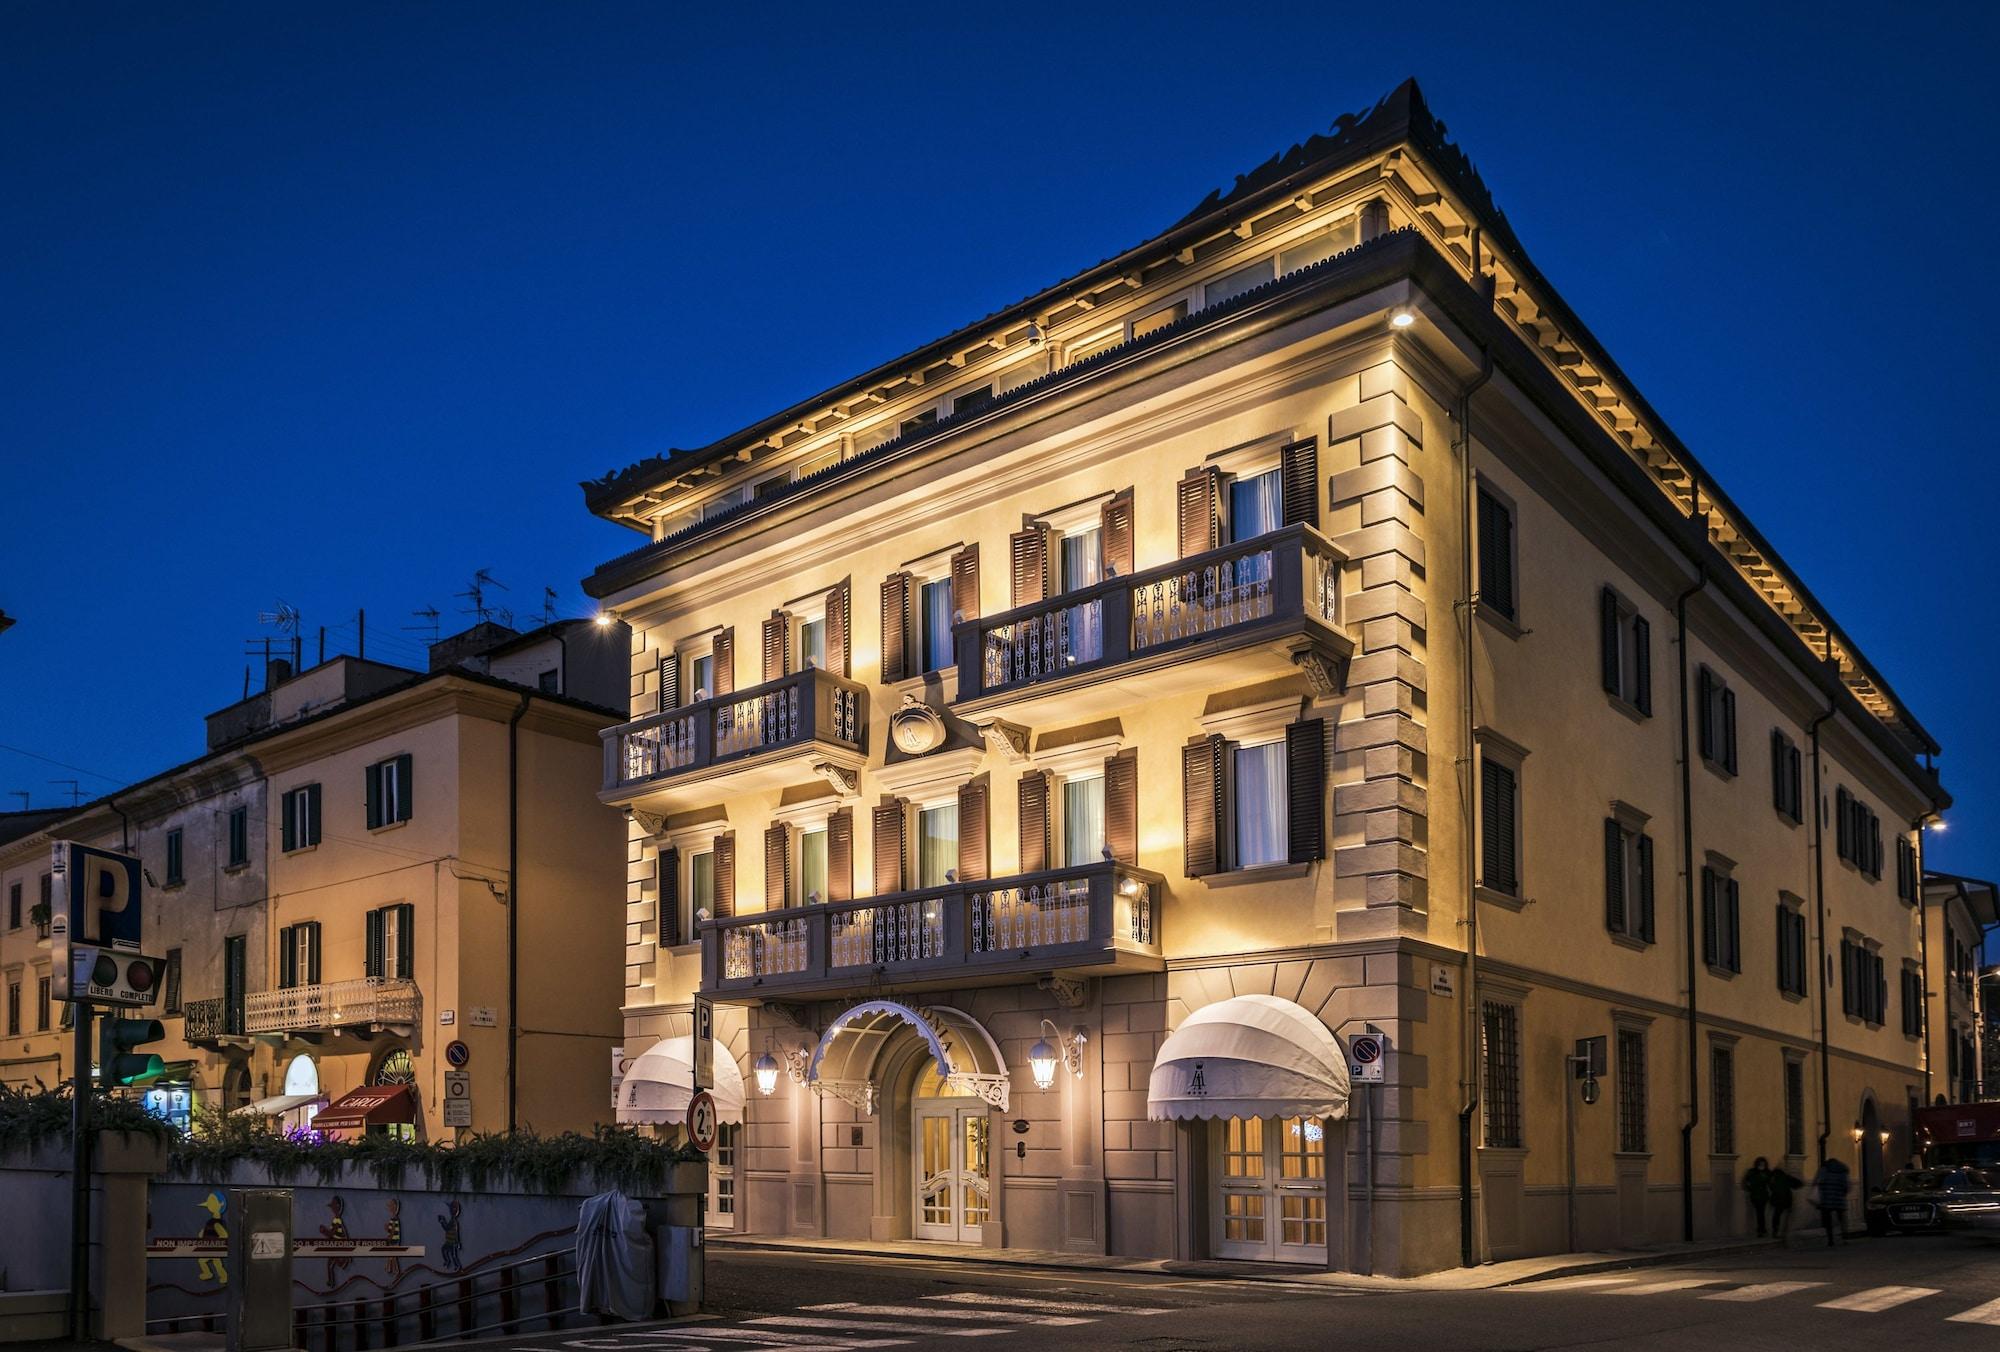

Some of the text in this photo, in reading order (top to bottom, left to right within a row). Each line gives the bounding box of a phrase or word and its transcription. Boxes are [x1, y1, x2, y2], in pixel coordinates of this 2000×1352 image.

[84, 852, 130, 941] P
[90, 986, 153, 1001] LIBERO COMPLETO
[701, 1006, 710, 1038] P
[339, 1097, 385, 1108] CARLO
[155, 1239, 227, 1249] NON IMPEGNARE
